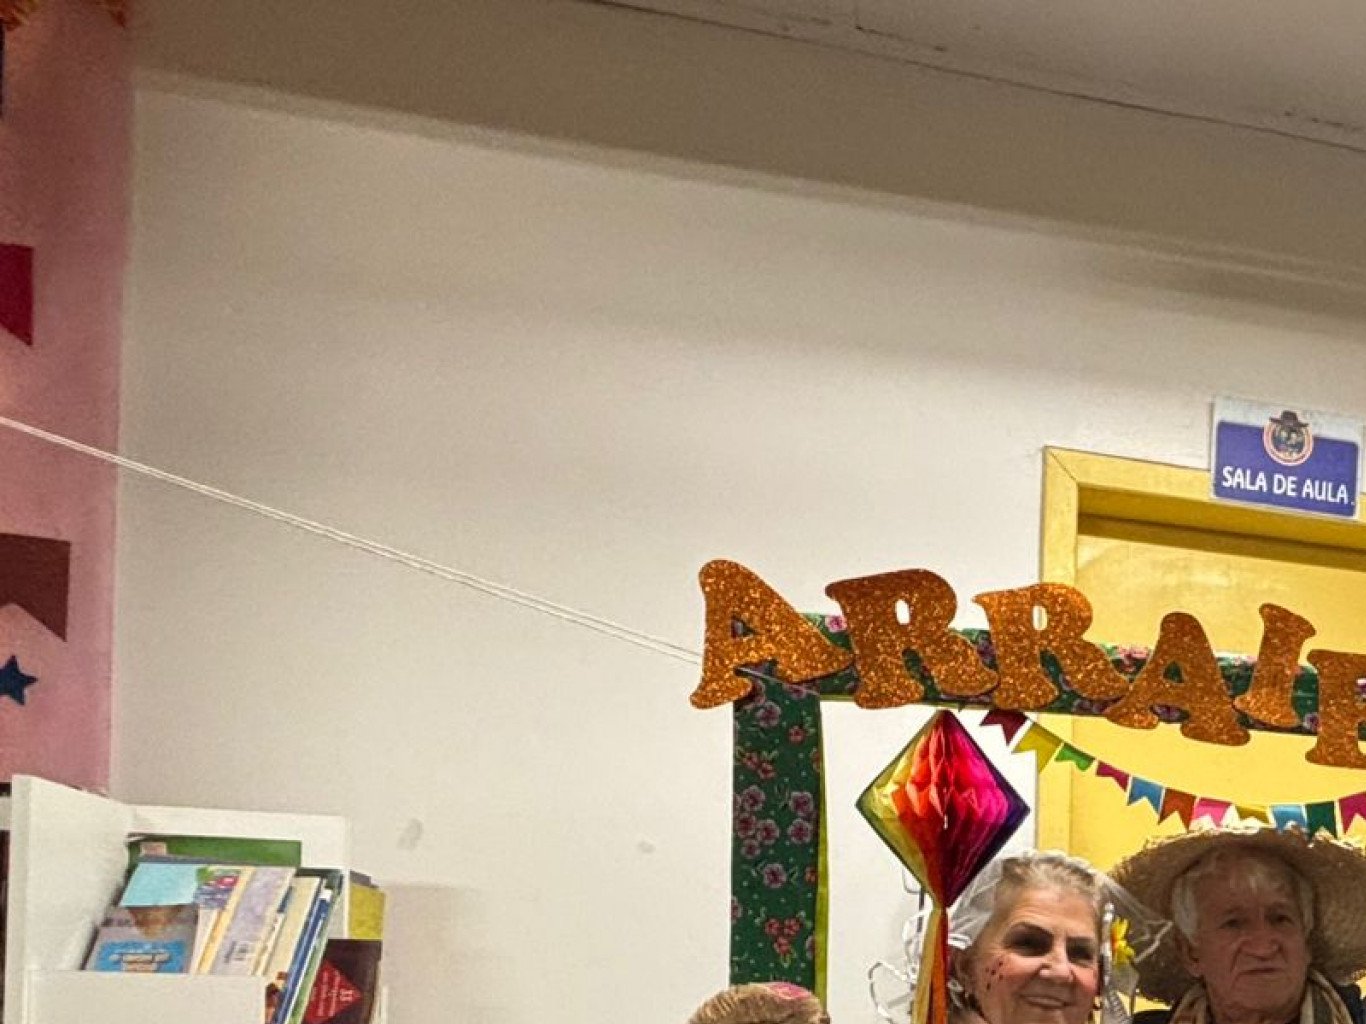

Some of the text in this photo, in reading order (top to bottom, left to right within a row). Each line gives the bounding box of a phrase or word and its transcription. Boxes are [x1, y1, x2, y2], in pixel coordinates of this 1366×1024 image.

[1222, 465, 1349, 505] SALA DE AULA
